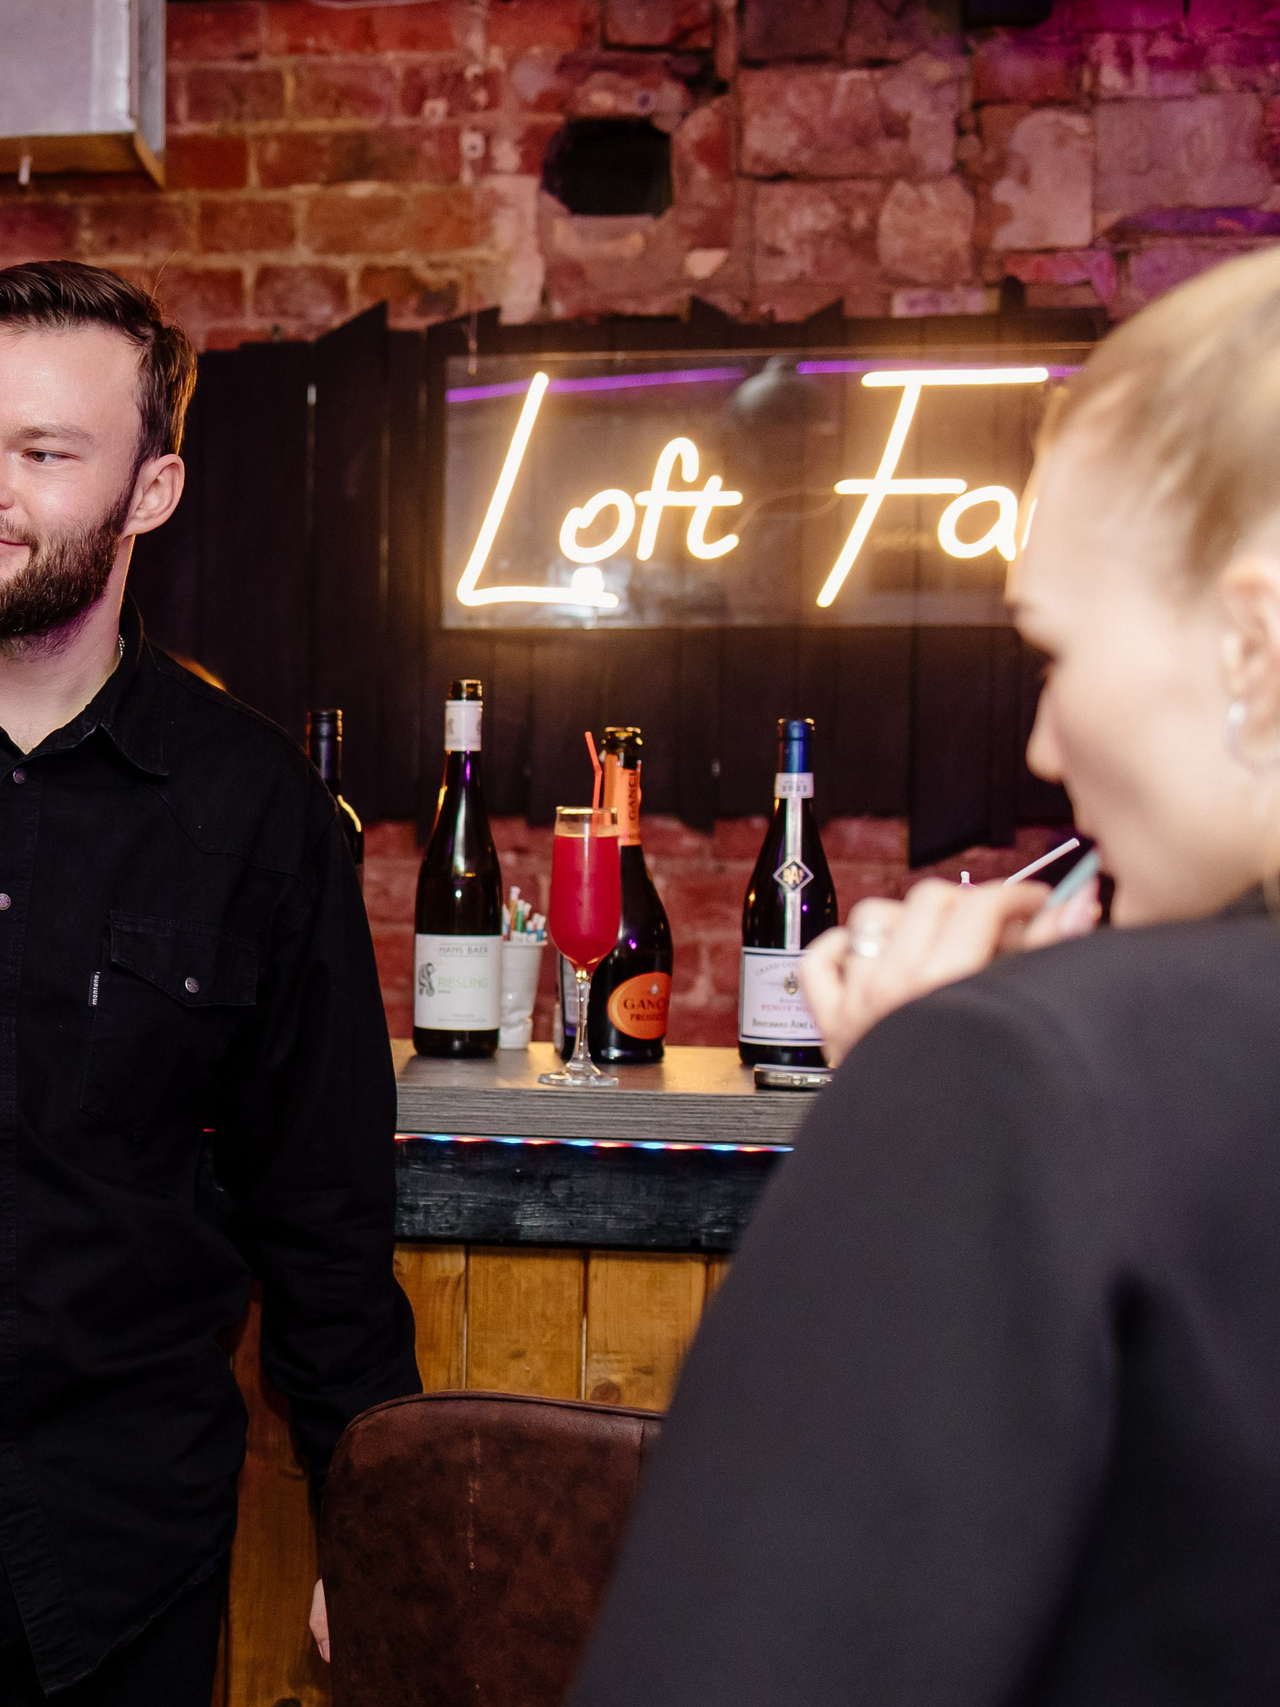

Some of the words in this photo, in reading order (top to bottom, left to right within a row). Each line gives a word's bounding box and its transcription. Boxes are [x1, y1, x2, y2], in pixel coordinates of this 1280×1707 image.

[456, 371, 743, 607] Loft
[816, 367, 1048, 607] Fa
[628, 771, 637, 821] GANCI
[623, 999, 665, 1010] GANC
